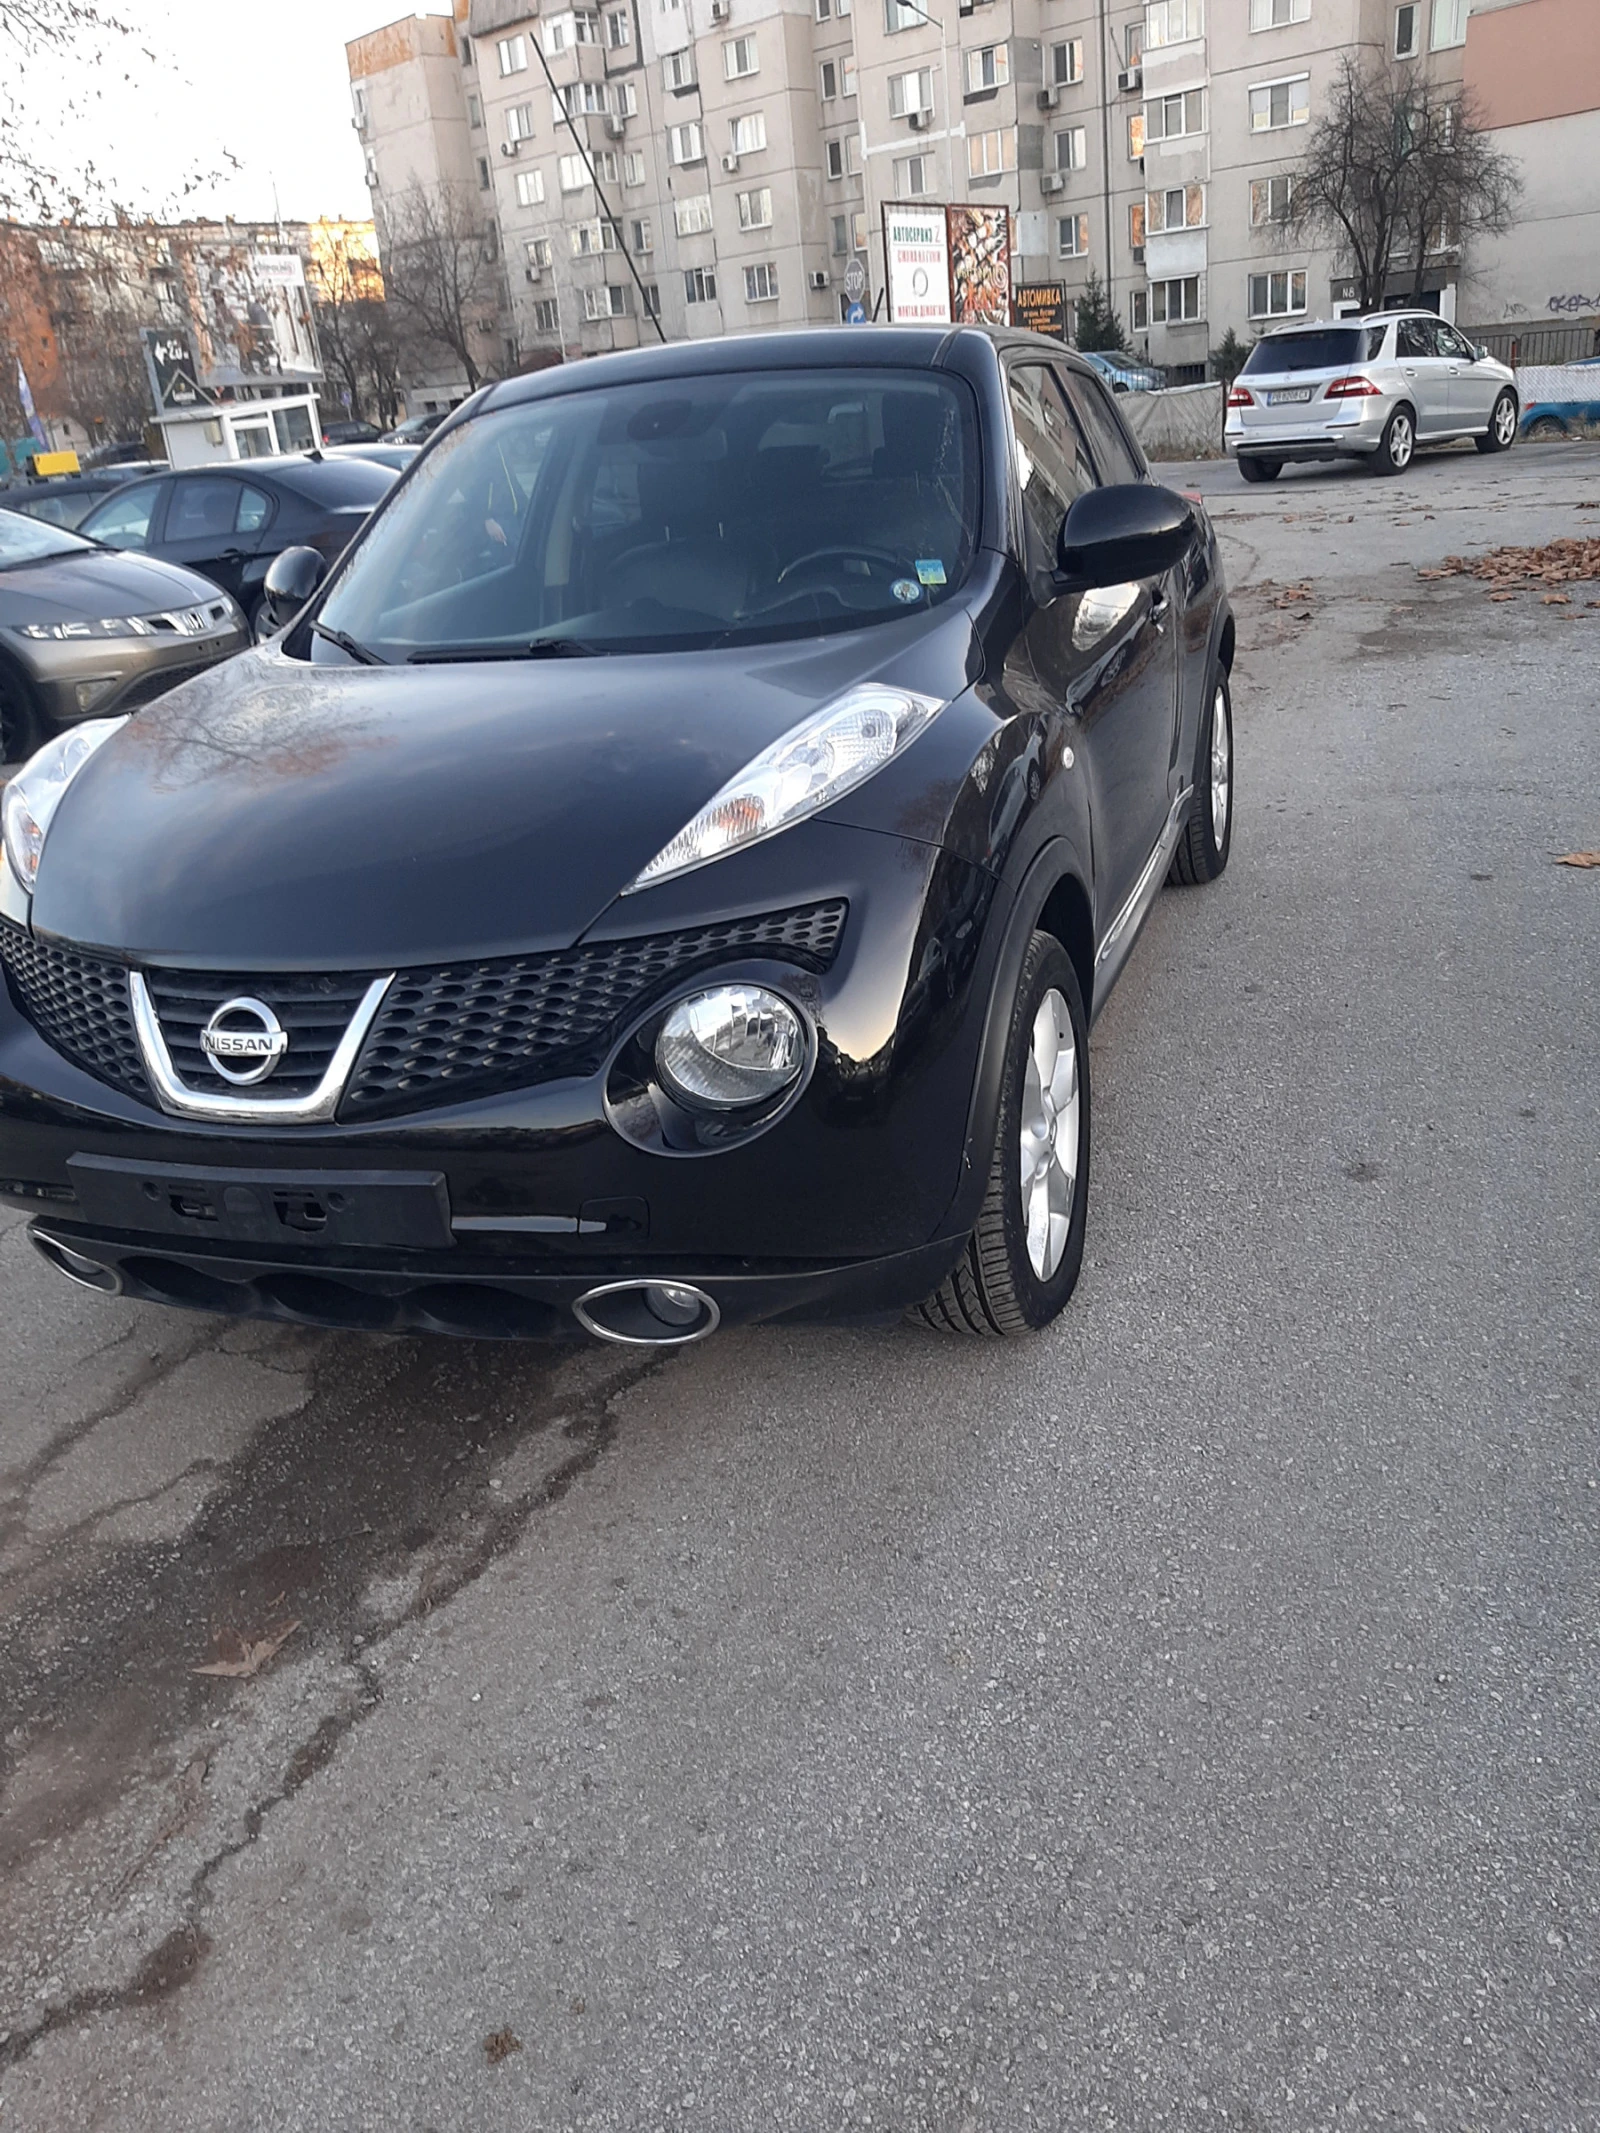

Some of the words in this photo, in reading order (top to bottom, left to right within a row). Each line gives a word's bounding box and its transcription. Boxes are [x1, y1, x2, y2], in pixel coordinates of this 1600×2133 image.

[893, 226, 933, 243] АВТОСЕРВИЗ
[846, 270, 863, 291] STOP
[1017, 288, 1061, 307] АВТОМИВКА
[205, 1035, 273, 1052] NISSAN
